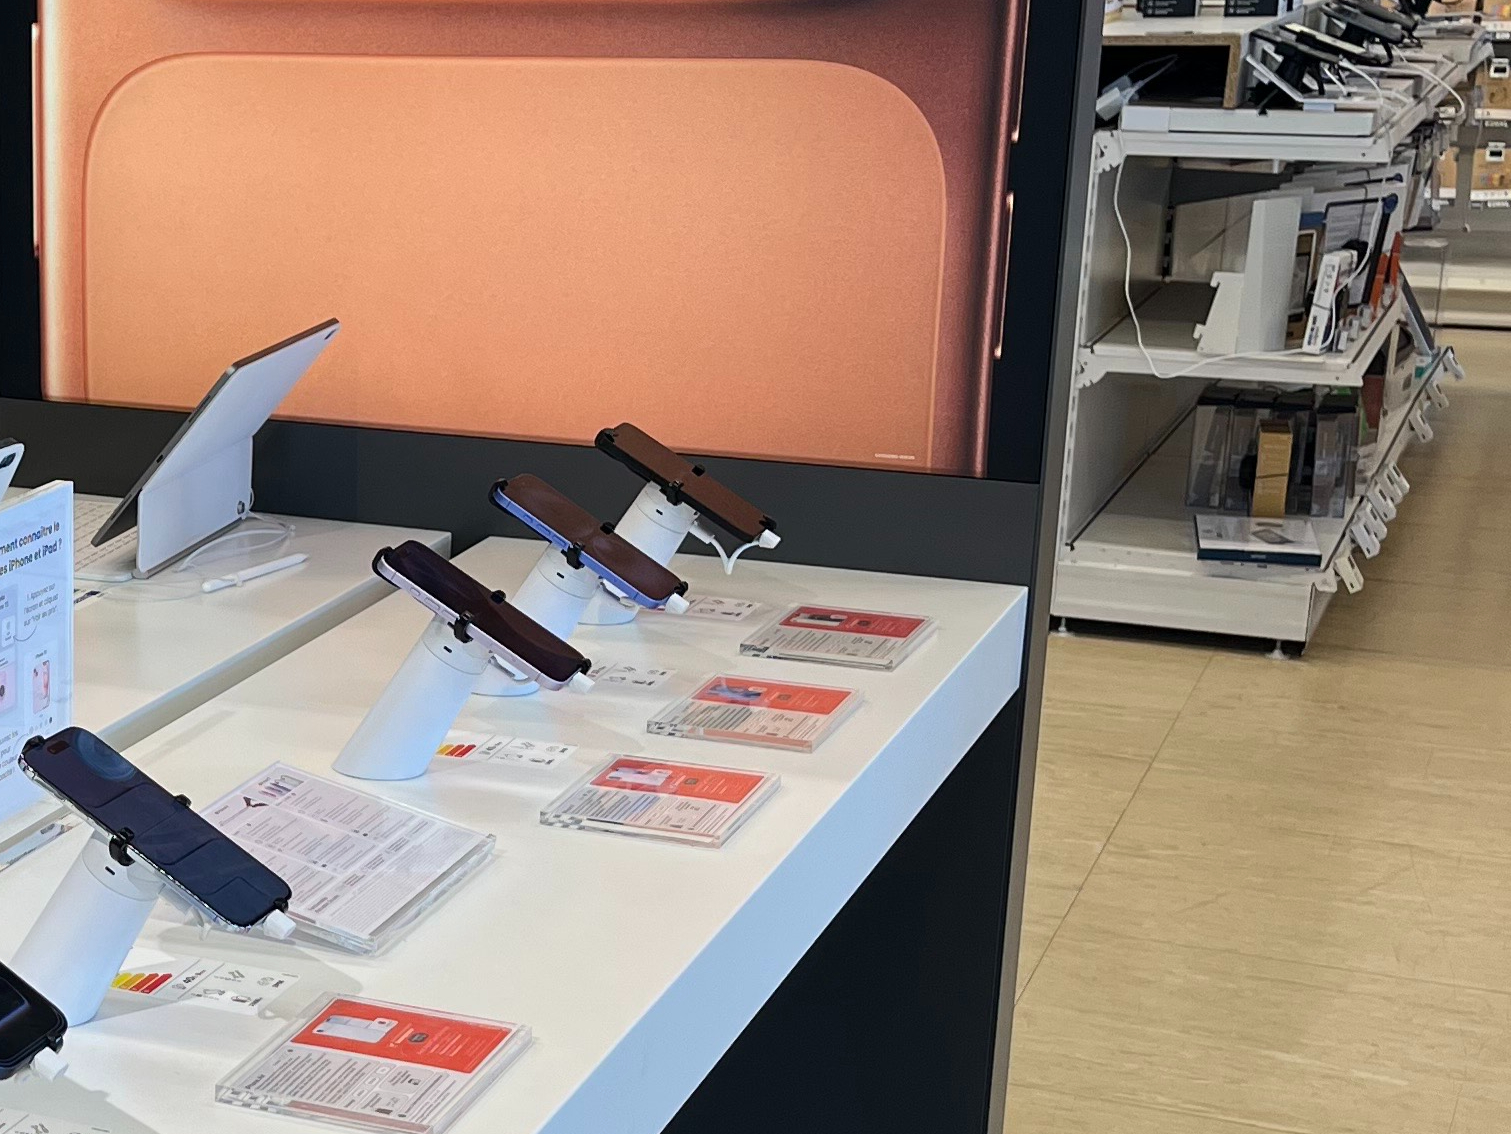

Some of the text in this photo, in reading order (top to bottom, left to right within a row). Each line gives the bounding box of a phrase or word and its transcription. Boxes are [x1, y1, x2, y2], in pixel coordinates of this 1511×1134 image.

[18, 525, 53, 548] connaître
[53, 521, 60, 533] le
[8, 552, 33, 572] iPhone
[33, 548, 42, 560] et
[42, 540, 58, 558] iPad
